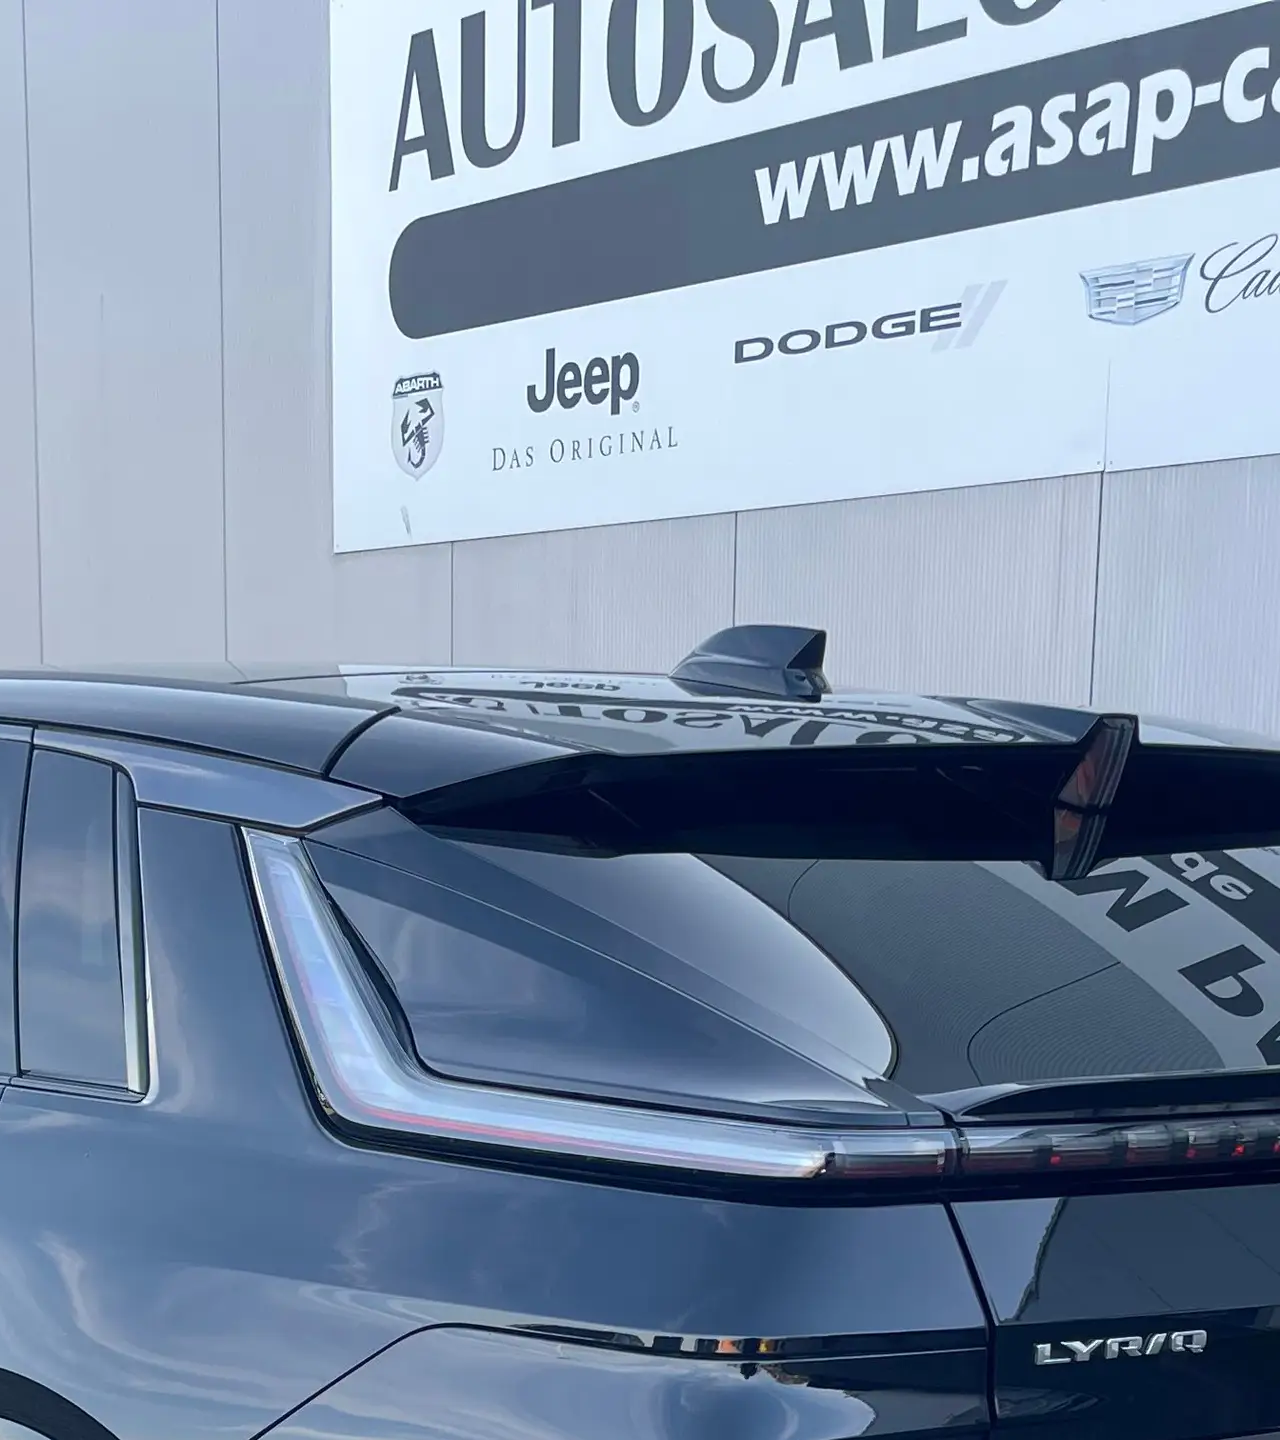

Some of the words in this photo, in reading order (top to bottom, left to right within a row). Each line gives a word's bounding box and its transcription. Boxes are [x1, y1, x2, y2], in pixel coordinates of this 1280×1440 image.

[388, 0, 1062, 192] AUTOSA
[734, 302, 963, 364] DODGE
[394, 377, 441, 394] ABARTH
[527, 348, 640, 416] Jeep
[492, 446, 535, 472] DAS
[550, 426, 679, 463] ORIGINAL
